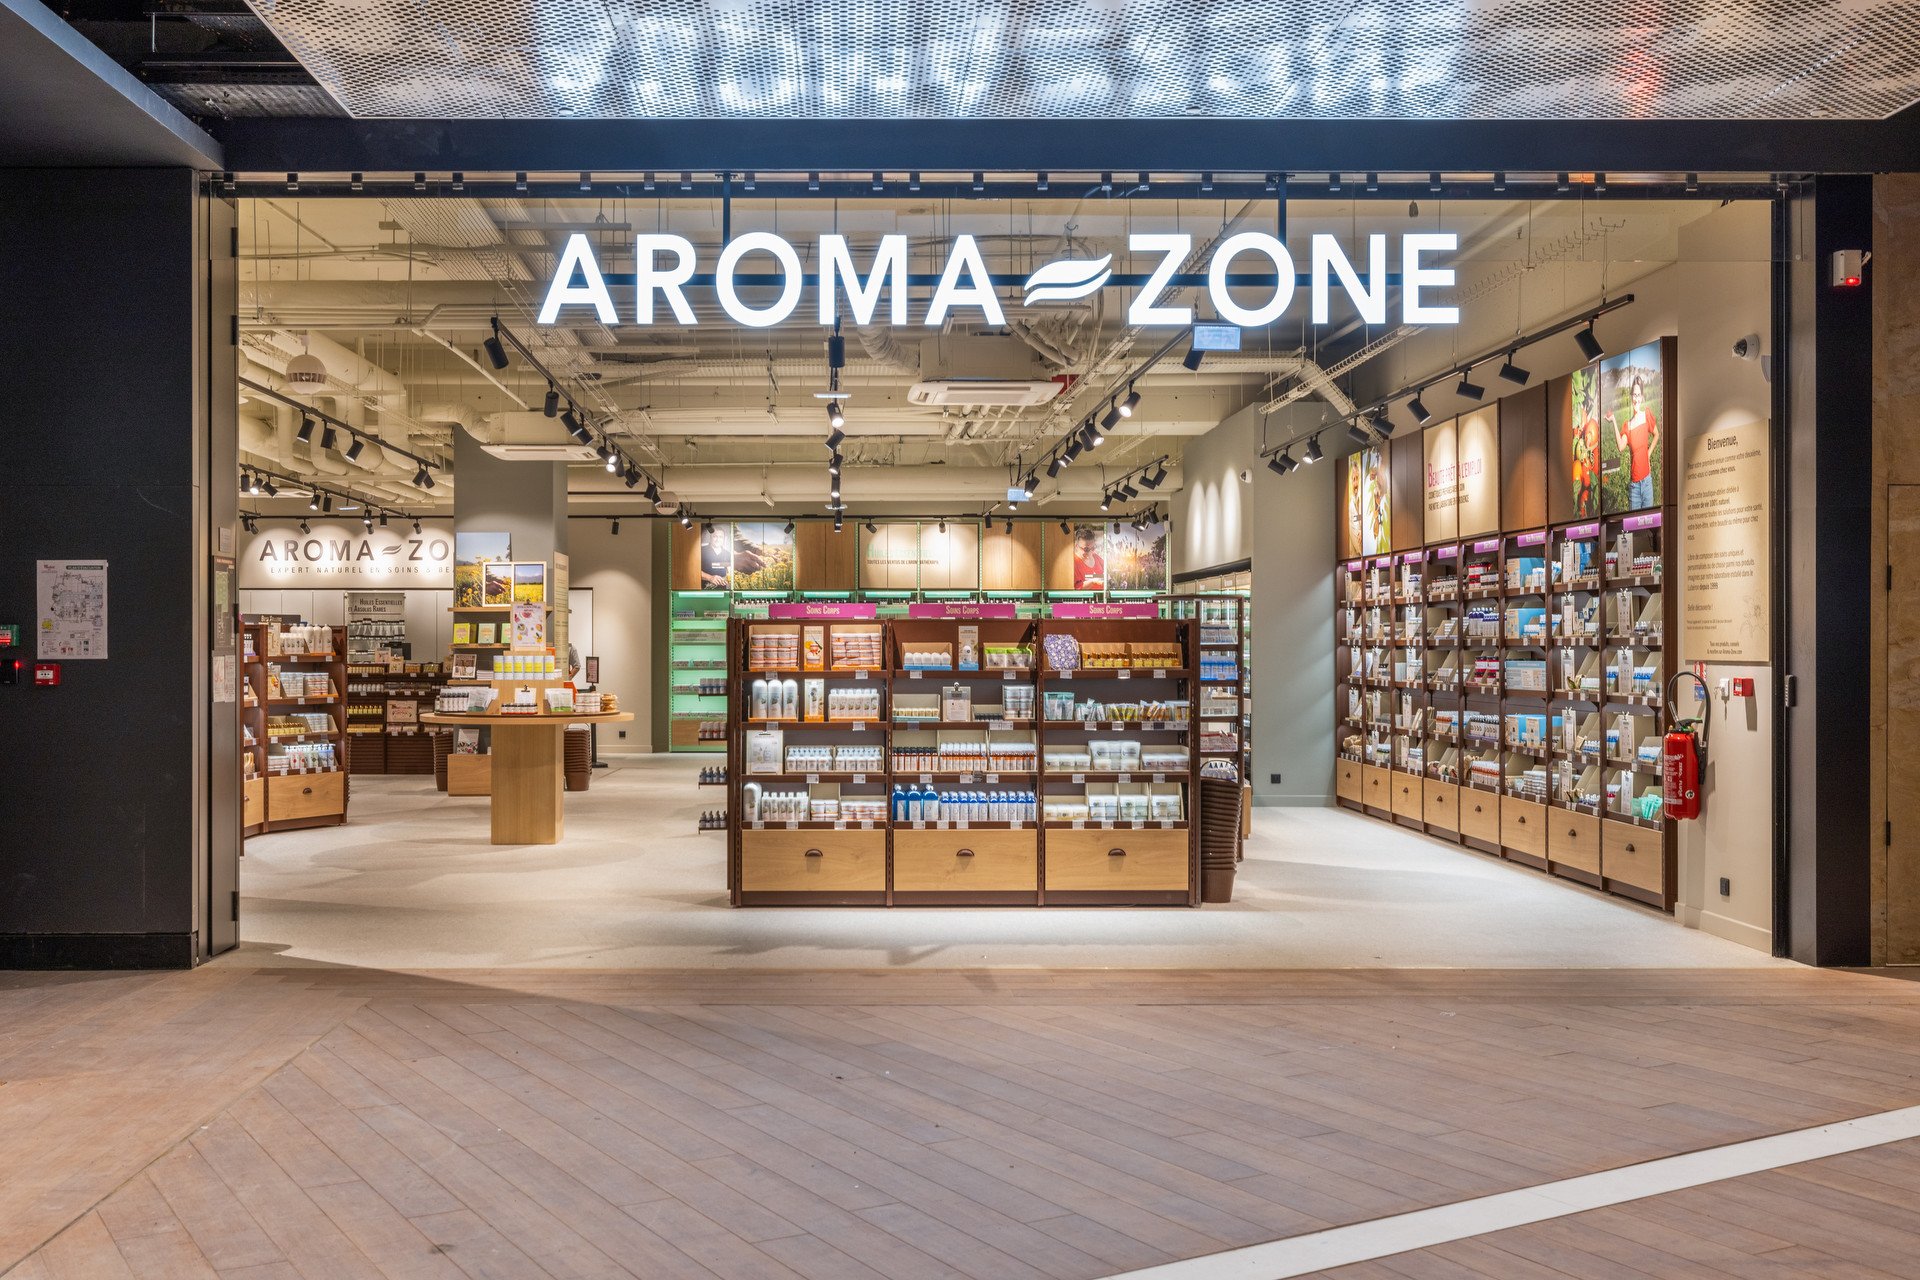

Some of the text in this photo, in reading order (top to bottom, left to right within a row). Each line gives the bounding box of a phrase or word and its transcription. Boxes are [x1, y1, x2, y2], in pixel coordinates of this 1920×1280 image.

[539, 233, 1458, 328] AROMA ZONE
[1708, 436, 1738, 450] Bienvenue,
[259, 540, 374, 562] AROMA
